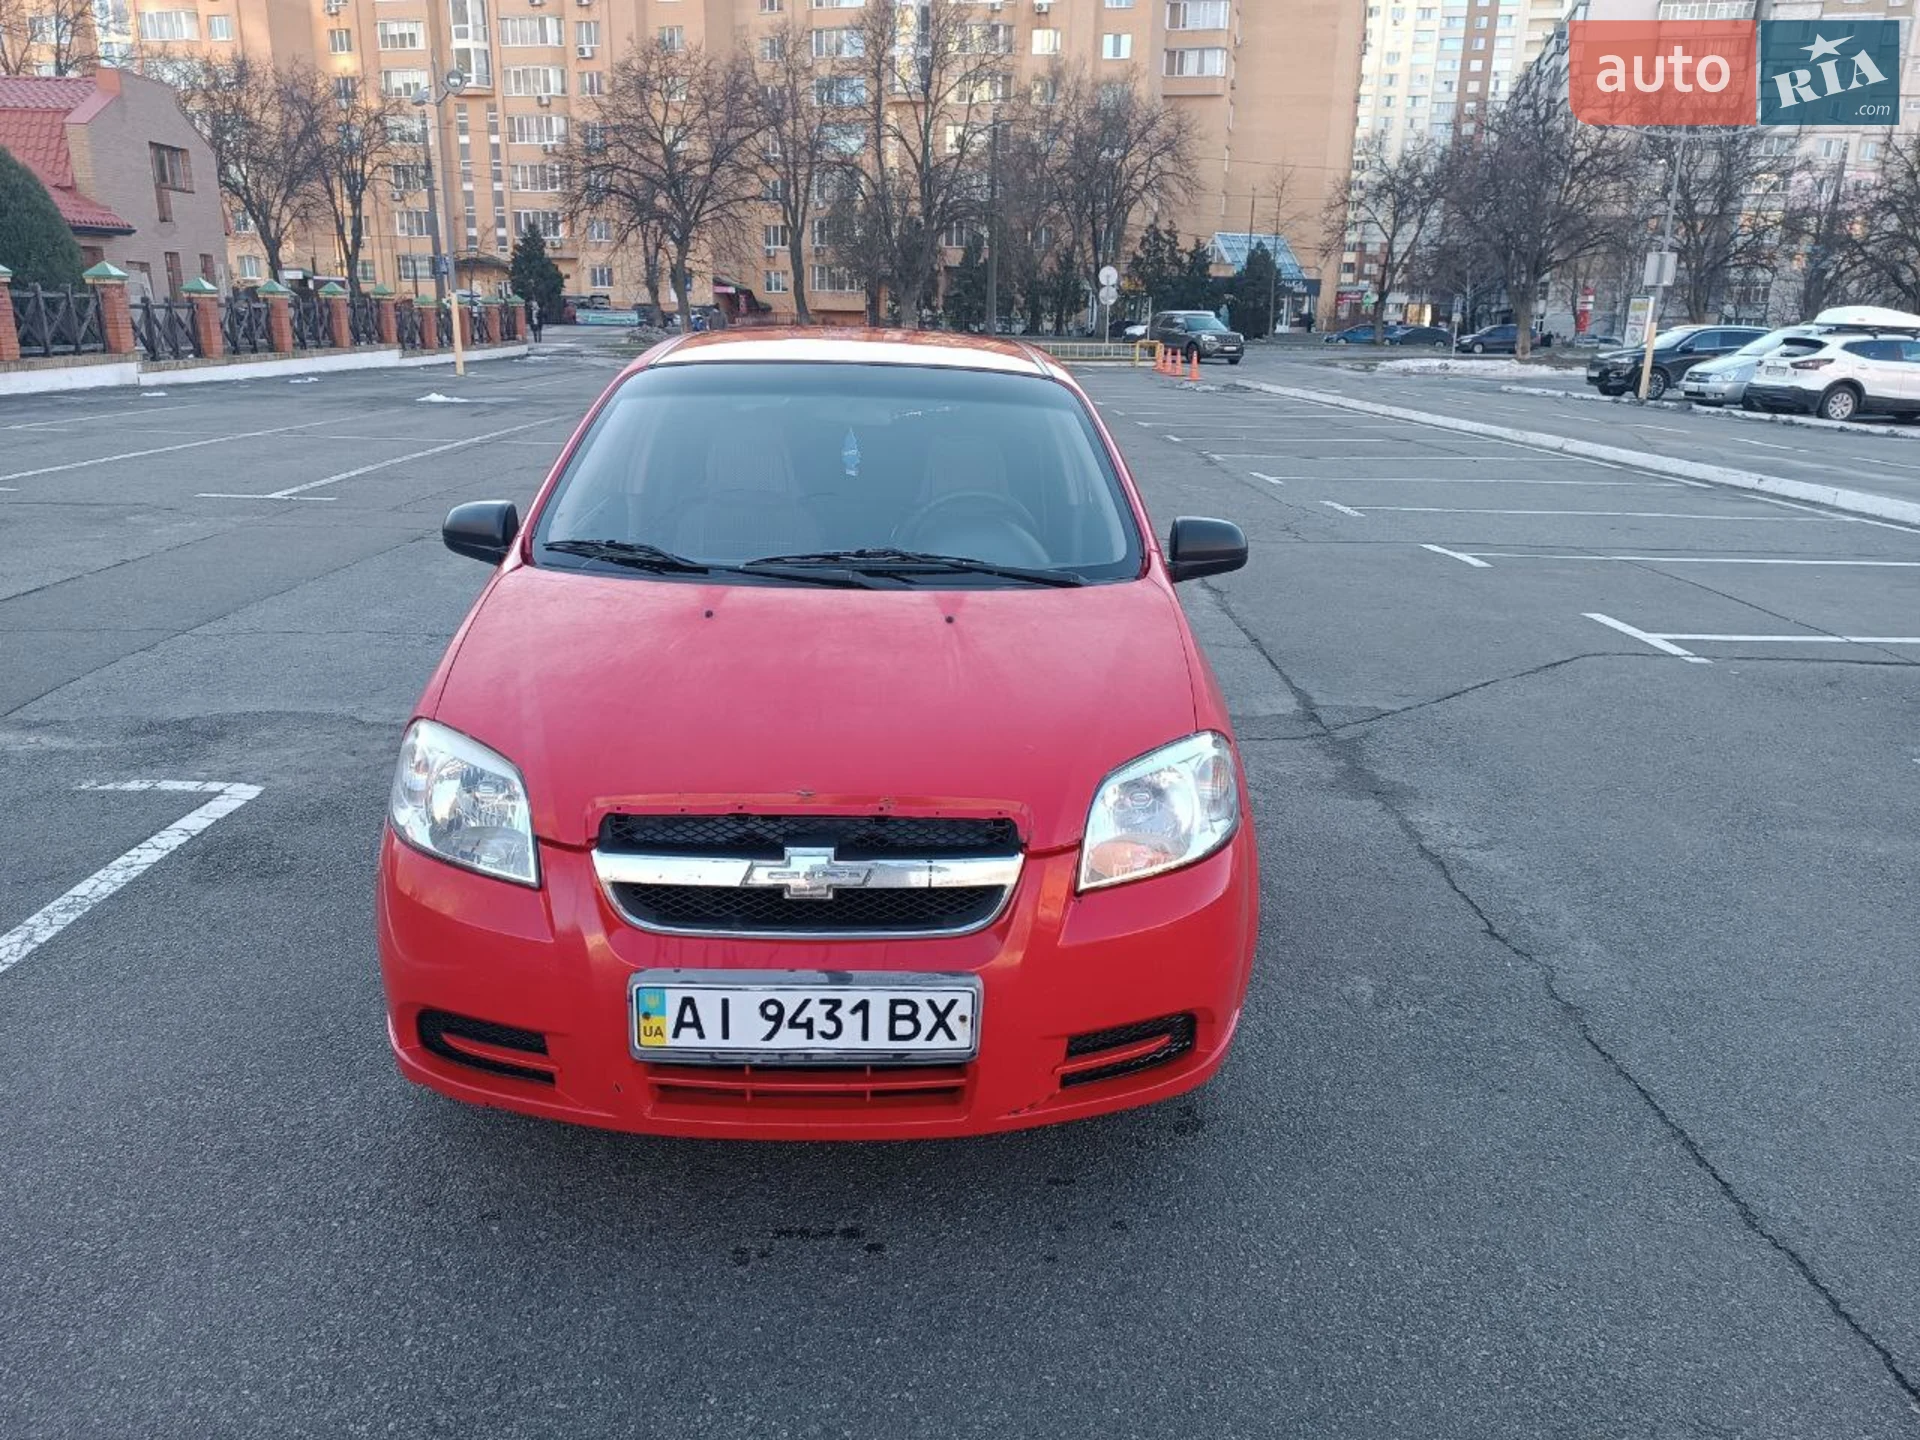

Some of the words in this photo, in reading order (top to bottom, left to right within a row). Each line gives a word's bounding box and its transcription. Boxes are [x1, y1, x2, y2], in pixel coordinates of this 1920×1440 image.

[643, 1025, 664, 1038] UA
[671, 996, 731, 1040] AI
[758, 998, 871, 1042] 9431
[888, 998, 959, 1042] BX
